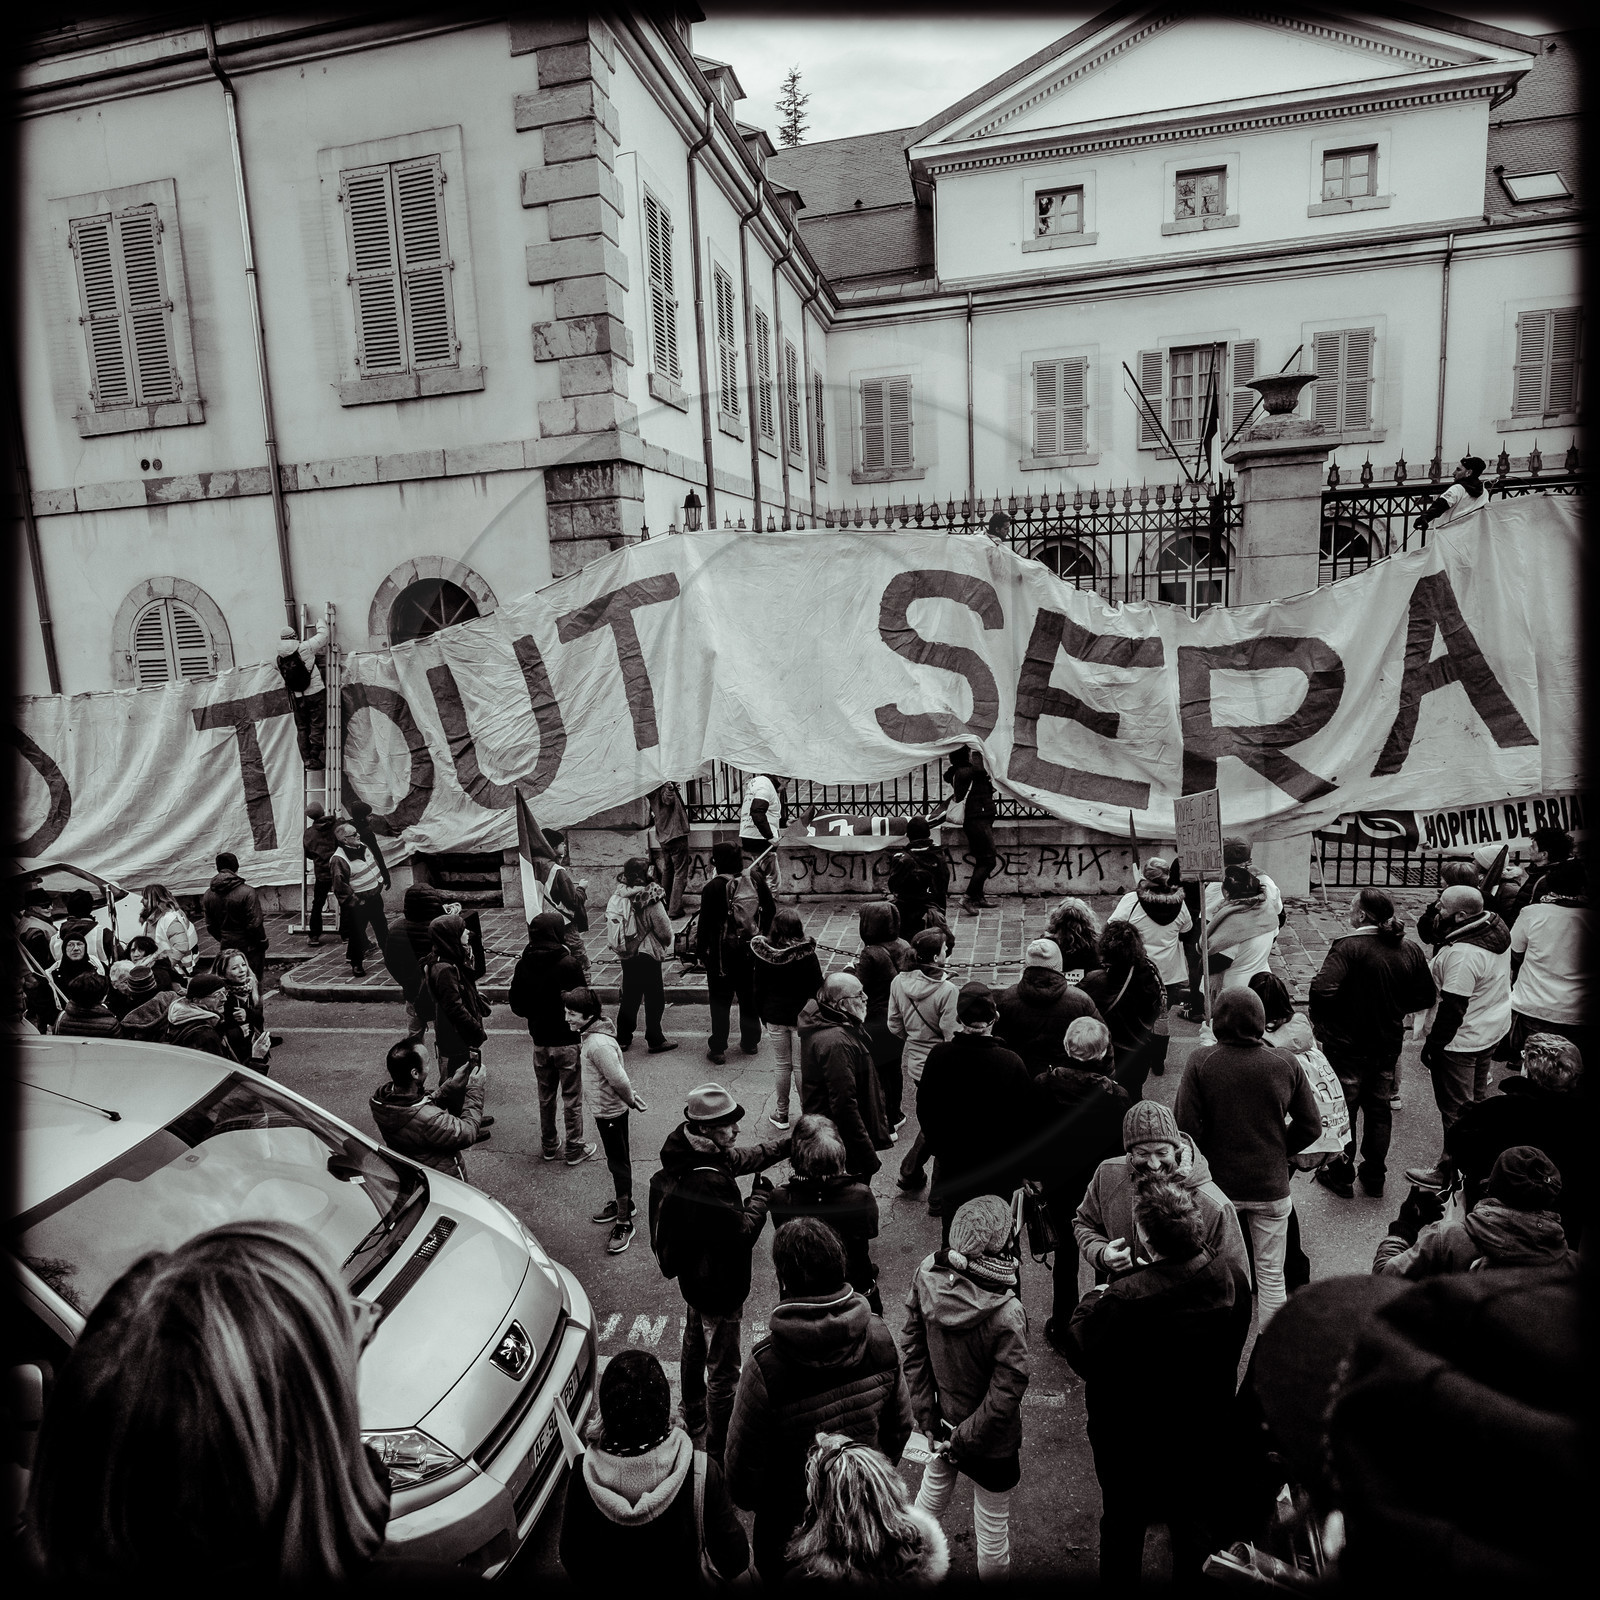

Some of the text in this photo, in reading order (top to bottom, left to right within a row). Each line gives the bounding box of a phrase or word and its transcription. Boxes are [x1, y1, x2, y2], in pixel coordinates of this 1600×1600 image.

[192, 571, 680, 852] TOUT
[875, 569, 1539, 810] SERA
[1422, 806, 1502, 850] HOPITAL
[1504, 801, 1531, 840] DE
[1533, 795, 1588, 831] BRIA
[789, 851, 897, 881] JUSTIC
[1037, 846, 1111, 881] PAIX
